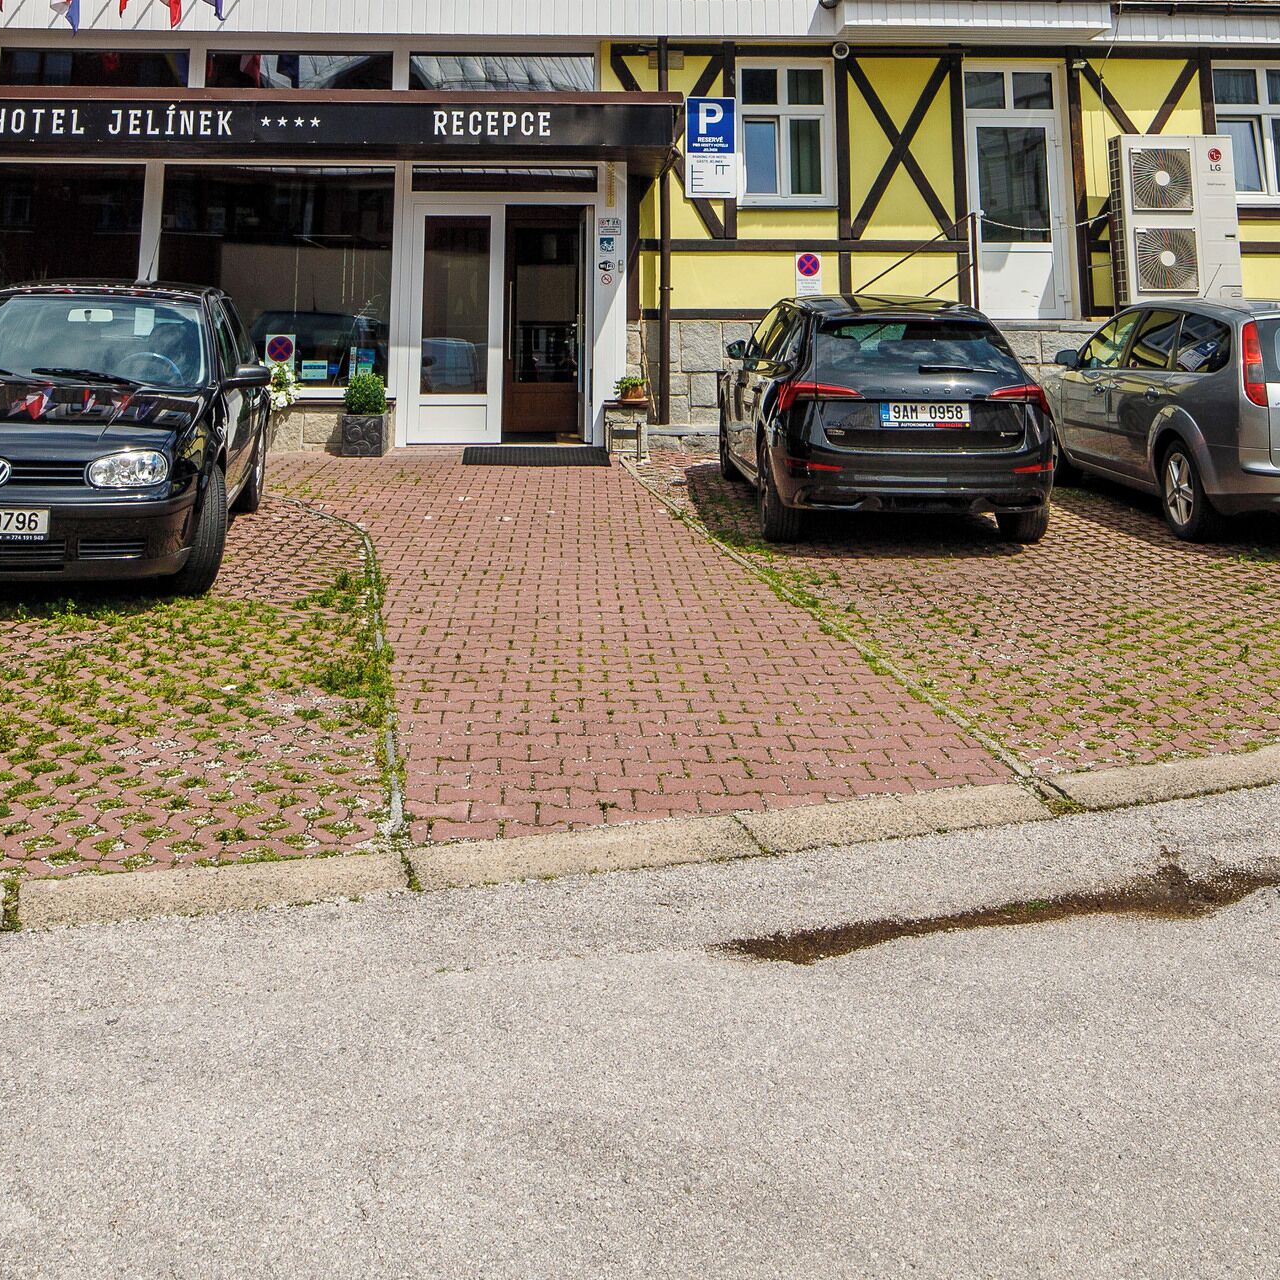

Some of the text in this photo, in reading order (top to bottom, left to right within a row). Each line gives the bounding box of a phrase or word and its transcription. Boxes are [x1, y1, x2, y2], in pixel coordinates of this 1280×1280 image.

[108, 104, 234, 135] JELÍNEK
[433, 110, 552, 136] RECEPCE
[699, 103, 724, 134] P
[893, 405, 918, 419] 9AM
[929, 405, 963, 420] 0958
